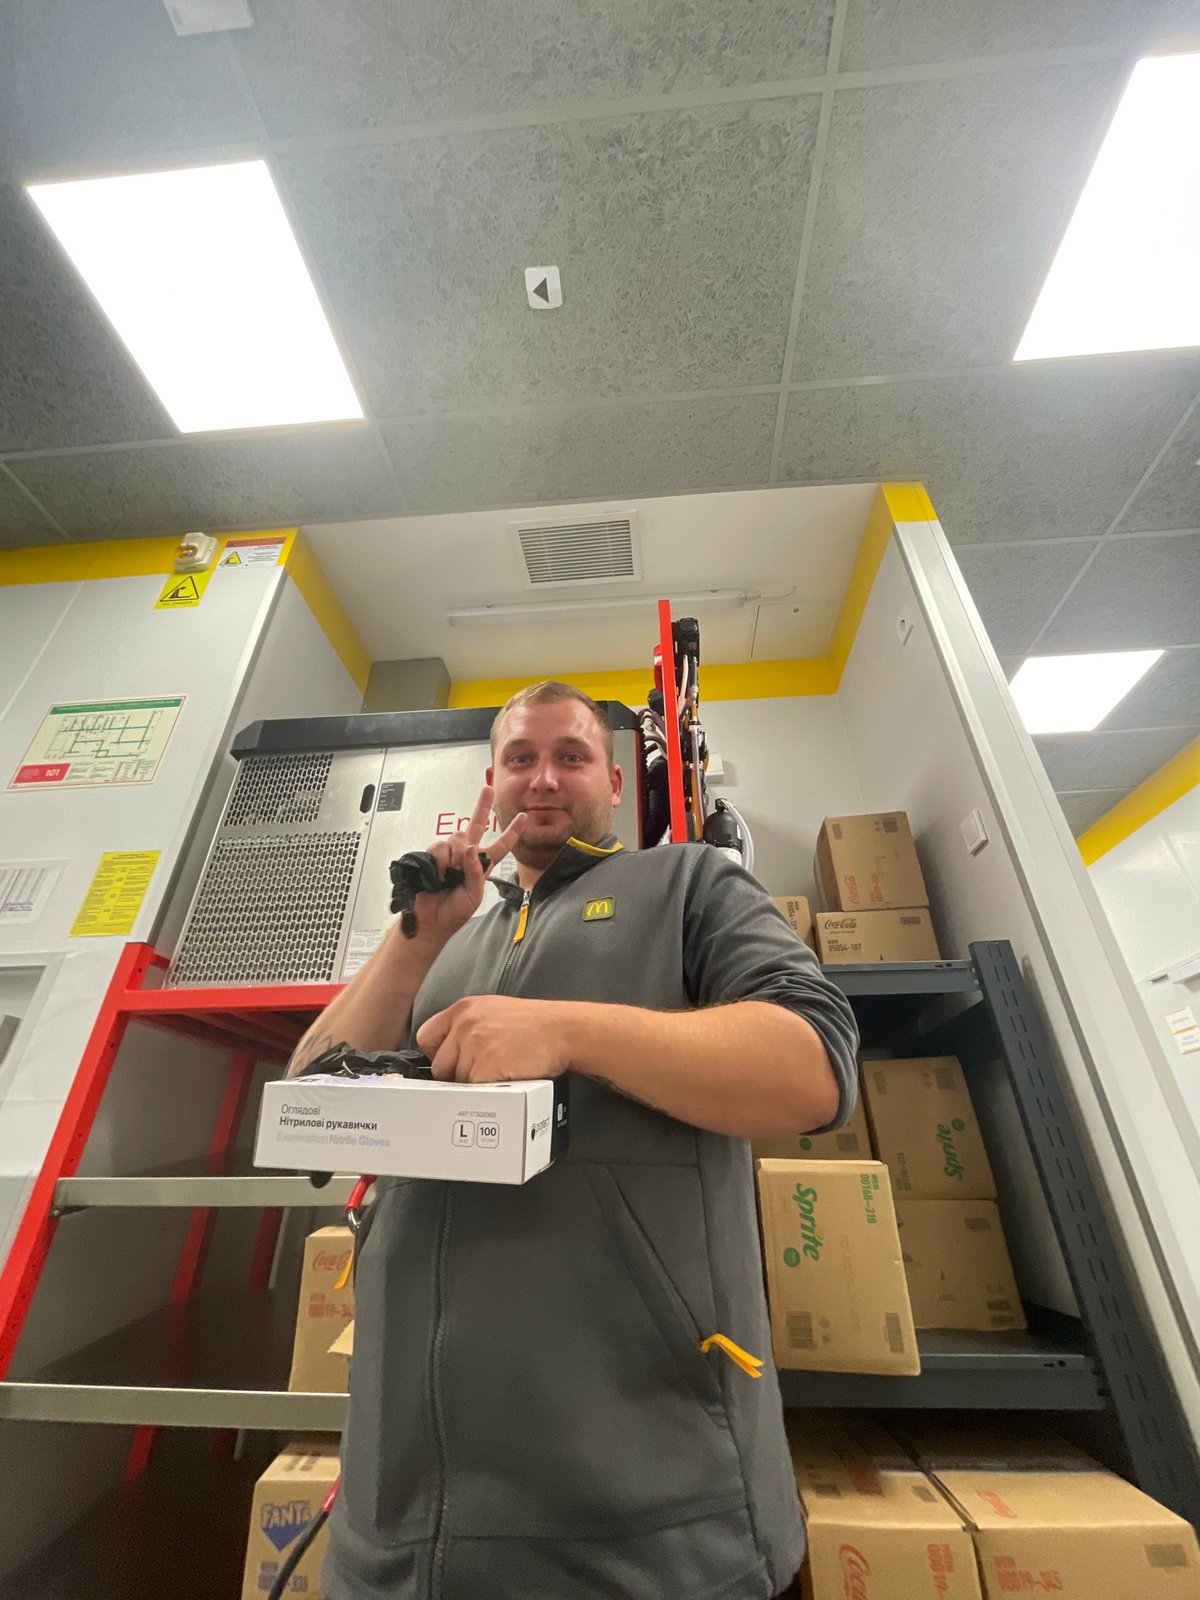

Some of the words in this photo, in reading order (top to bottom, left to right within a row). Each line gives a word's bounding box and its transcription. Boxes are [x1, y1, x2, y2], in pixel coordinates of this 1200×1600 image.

[45, 768, 61, 776] 101
[281, 1103, 321, 1116] Оглядові
[279, 1116, 325, 1129] Нітрилові
[326, 1119, 378, 1131] рукавички
[460, 1124, 468, 1138] L
[480, 1126, 497, 1137] 100
[358, 1136, 391, 1148] Gloves
[936, 1124, 964, 1180] Sprite
[792, 1181, 823, 1261] Sprite
